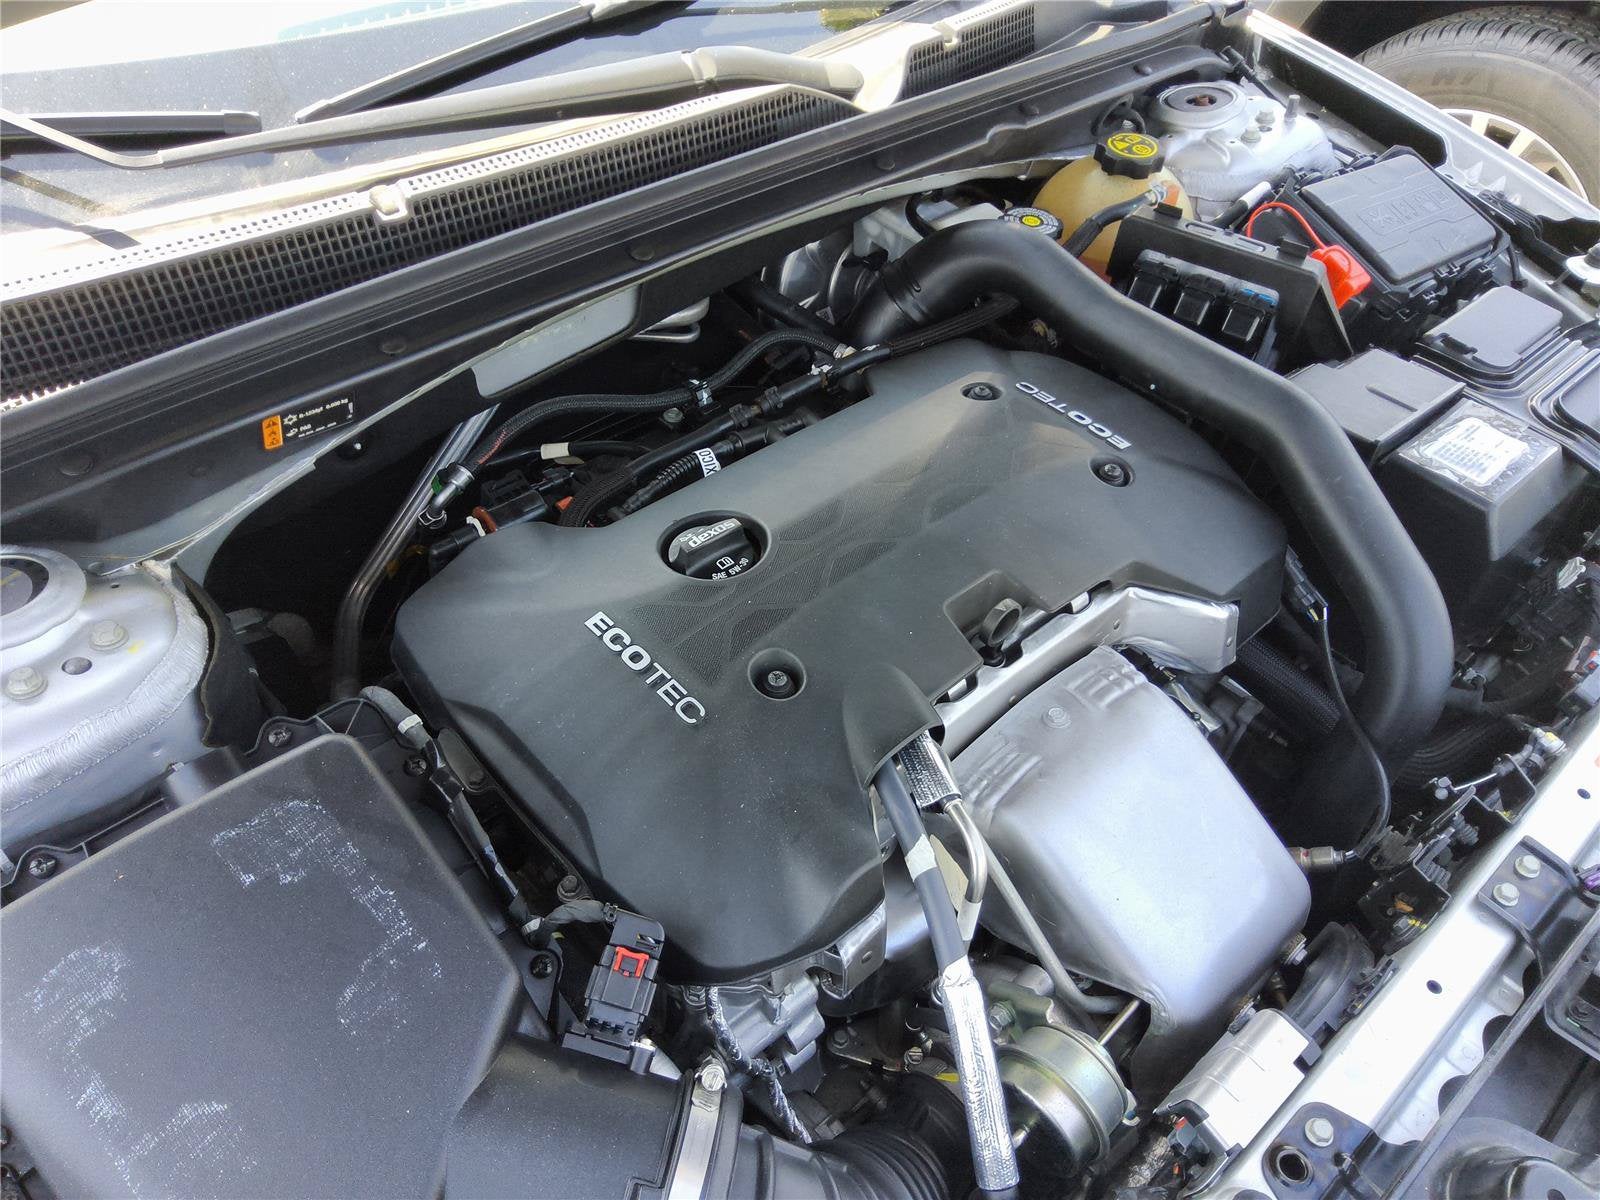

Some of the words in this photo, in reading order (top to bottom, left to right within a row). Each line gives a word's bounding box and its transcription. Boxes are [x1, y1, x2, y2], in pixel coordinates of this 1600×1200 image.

[1016, 382, 1132, 450] ECOTEC
[688, 521, 736, 548] dexos
[711, 572, 728, 581] SAE
[728, 557, 749, 576] 5W-30
[584, 611, 706, 724] ECOTEC
